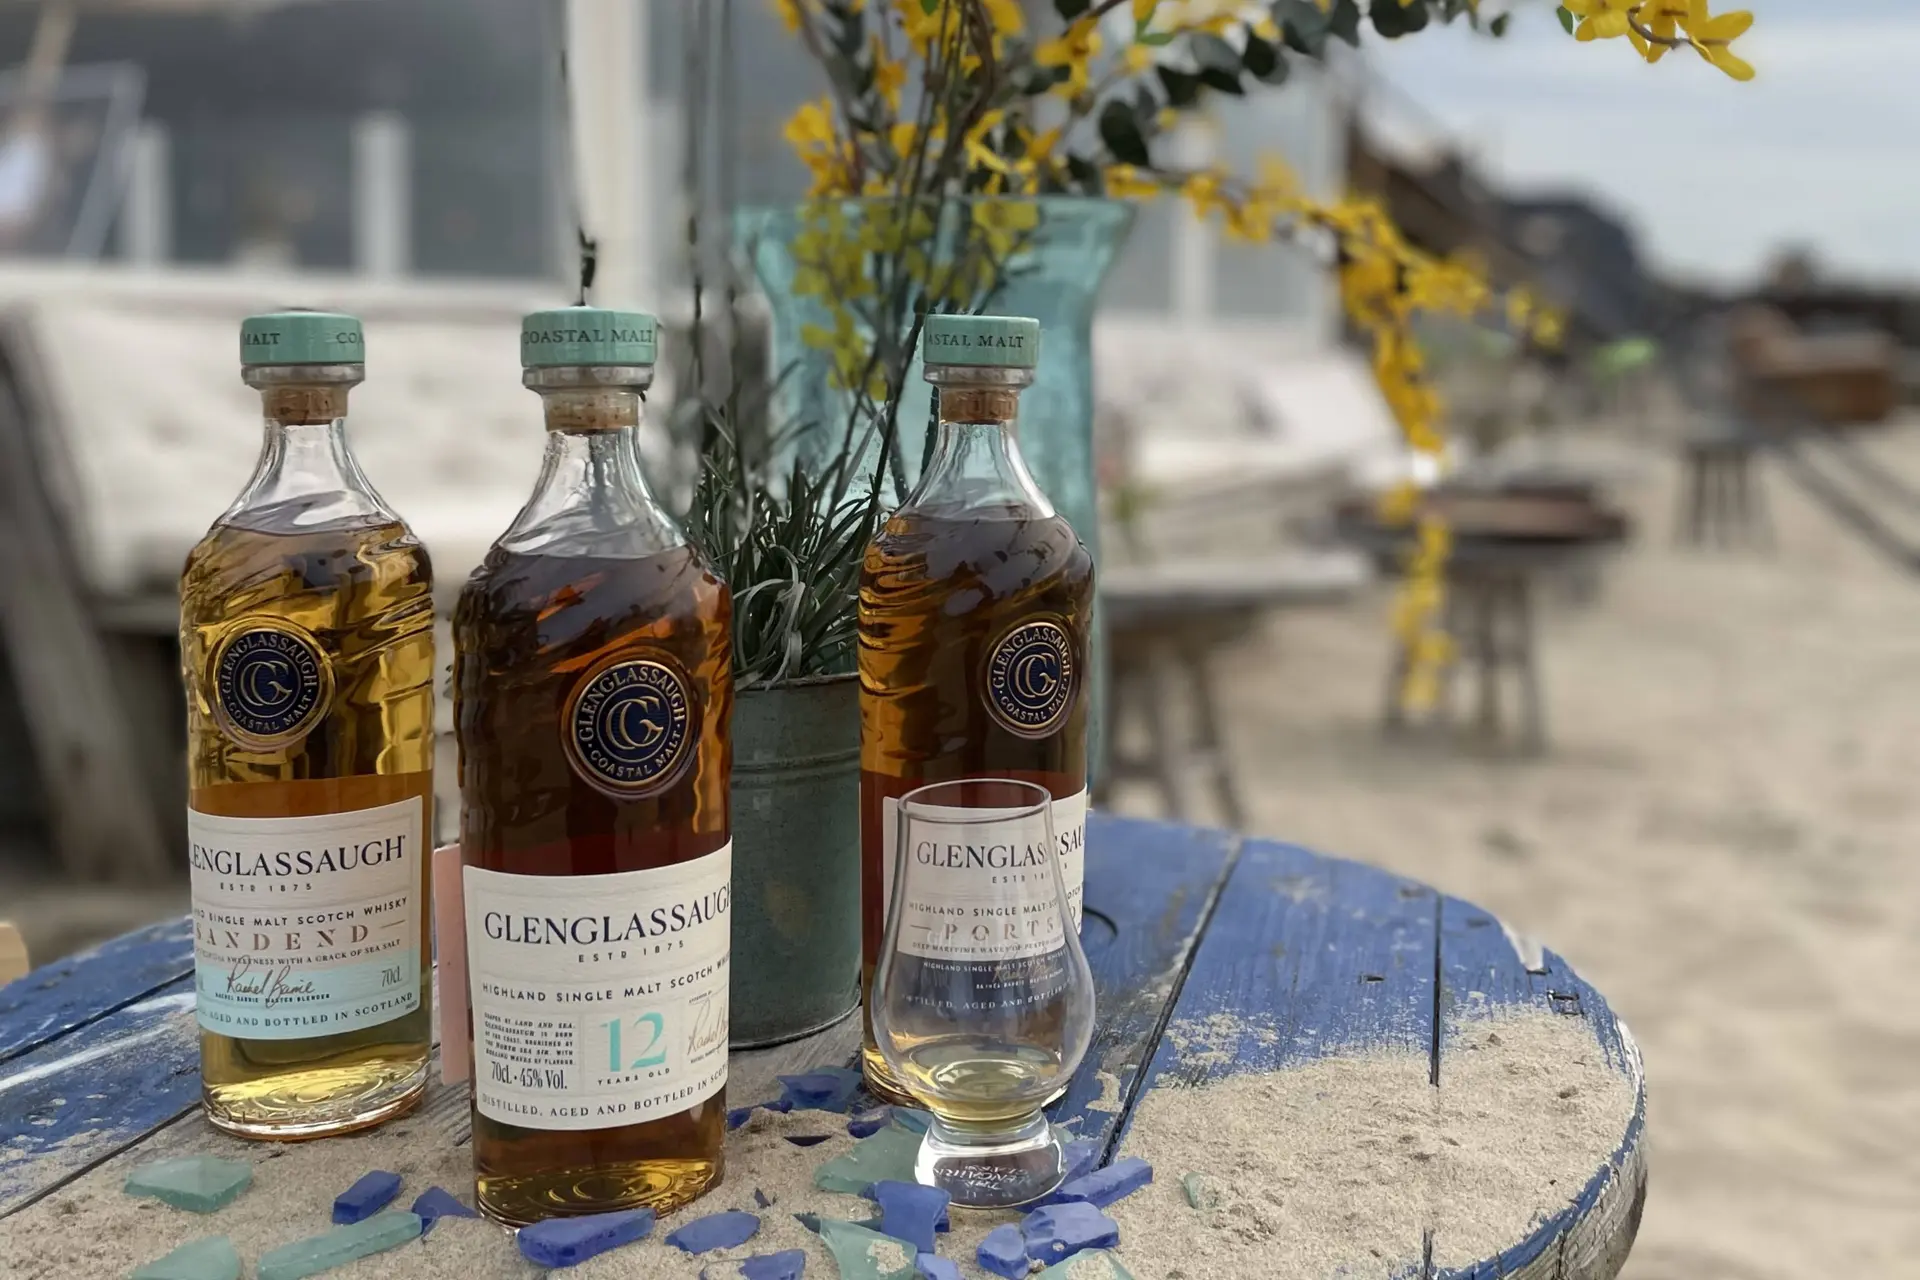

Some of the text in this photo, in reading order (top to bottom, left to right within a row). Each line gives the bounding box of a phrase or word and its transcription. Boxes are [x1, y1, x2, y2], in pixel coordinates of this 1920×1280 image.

[524, 329, 652, 345] COASTAL MALT
[977, 335, 1024, 348] MALT
[221, 633, 318, 694] GLENGLASSAUGH
[992, 627, 1071, 689] GLENGLASSAUGH
[228, 694, 312, 731] COASTAL MALT
[578, 666, 686, 742] GLENGLASSAUGH
[1001, 683, 1067, 722] COASTAL MALT
[590, 729, 681, 778] COASTAL MALT
[269, 882, 312, 892] 1875
[209, 912, 245, 926] SINGLE
[253, 917, 288, 926] MALT
[297, 910, 355, 925] SCOTCH
[364, 896, 407, 916] WHISKY
[973, 907, 1017, 917] SINGLE
[1023, 903, 1046, 914] MALT
[278, 957, 303, 965] WITH
[365, 945, 381, 954] SEA
[383, 938, 401, 950] SALT
[643, 940, 684, 956] 1875
[482, 982, 546, 1002] HIGHLAND
[556, 990, 612, 1002] SINGLE
[624, 983, 661, 997] MALT
[670, 964, 713, 989] SCOTCH
[236, 1017, 259, 1026] AND
[264, 1014, 328, 1027] BOTTLED
[335, 1012, 349, 1020] IN
[355, 992, 413, 1016] SCOTLAND
[963, 1001, 996, 1010] AGED
[1001, 999, 1023, 1008] AND
[599, 1011, 667, 1072] 12
[519, 1067, 543, 1089] 45%
[545, 1068, 568, 1090] Vol.
[597, 1067, 671, 1086] YEARS OLD
[550, 1107, 589, 1117] AGED
[596, 1103, 627, 1115] AND
[634, 1086, 694, 1110] BOTTLED
[697, 1079, 708, 1091] IN
